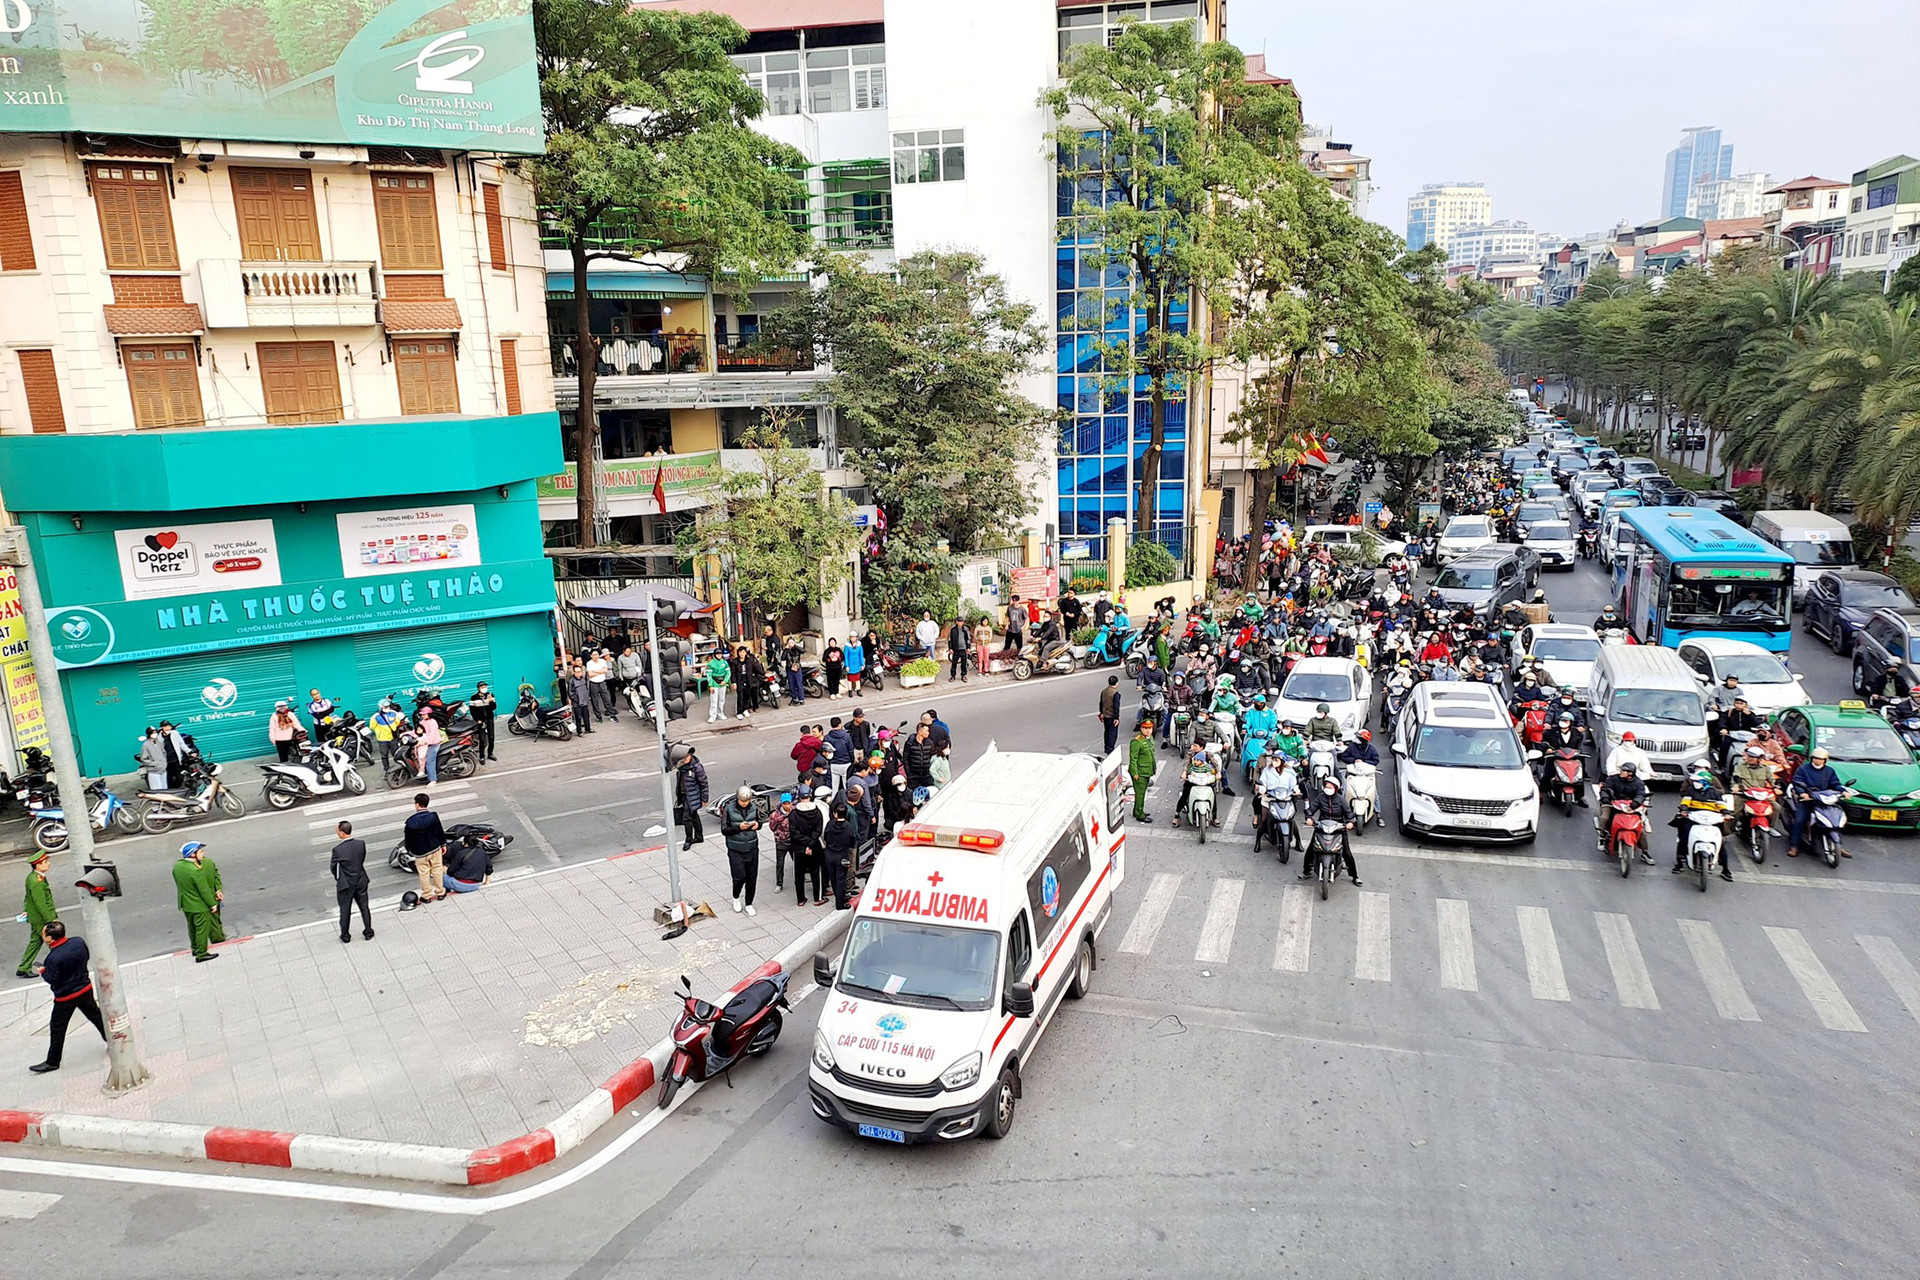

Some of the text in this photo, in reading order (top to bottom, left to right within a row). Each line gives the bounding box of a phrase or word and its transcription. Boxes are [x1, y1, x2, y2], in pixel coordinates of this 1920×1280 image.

[3, 84, 65, 105] xanh
[397, 93, 493, 111] CIPUTRA HANOI
[357, 114, 383, 127] Khu
[410, 116, 431, 131] Thị
[433, 118, 463, 131] Nam
[506, 122, 536, 136] Long
[554, 469, 575, 489] TRẺ
[617, 468, 639, 487] NAY
[640, 462, 657, 485] THẾ
[415, 511, 430, 519] 125
[137, 548, 189, 565] Doppel
[150, 561, 182, 574] herz
[156, 599, 229, 630] NHÀ
[241, 585, 347, 620] THUỐC
[360, 579, 415, 606] TUỆ
[427, 571, 504, 599] THẢO
[2, 640, 29, 657] CHẶT
[224, 709, 256, 718] Pharmacy
[837, 1000, 859, 1015] 34
[837, 1032, 858, 1048] CẤP
[881, 1039, 899, 1055] 115
[900, 1041, 915, 1057] HÀ
[915, 1045, 936, 1062] NỘI
[860, 1062, 907, 1079] IVECO
